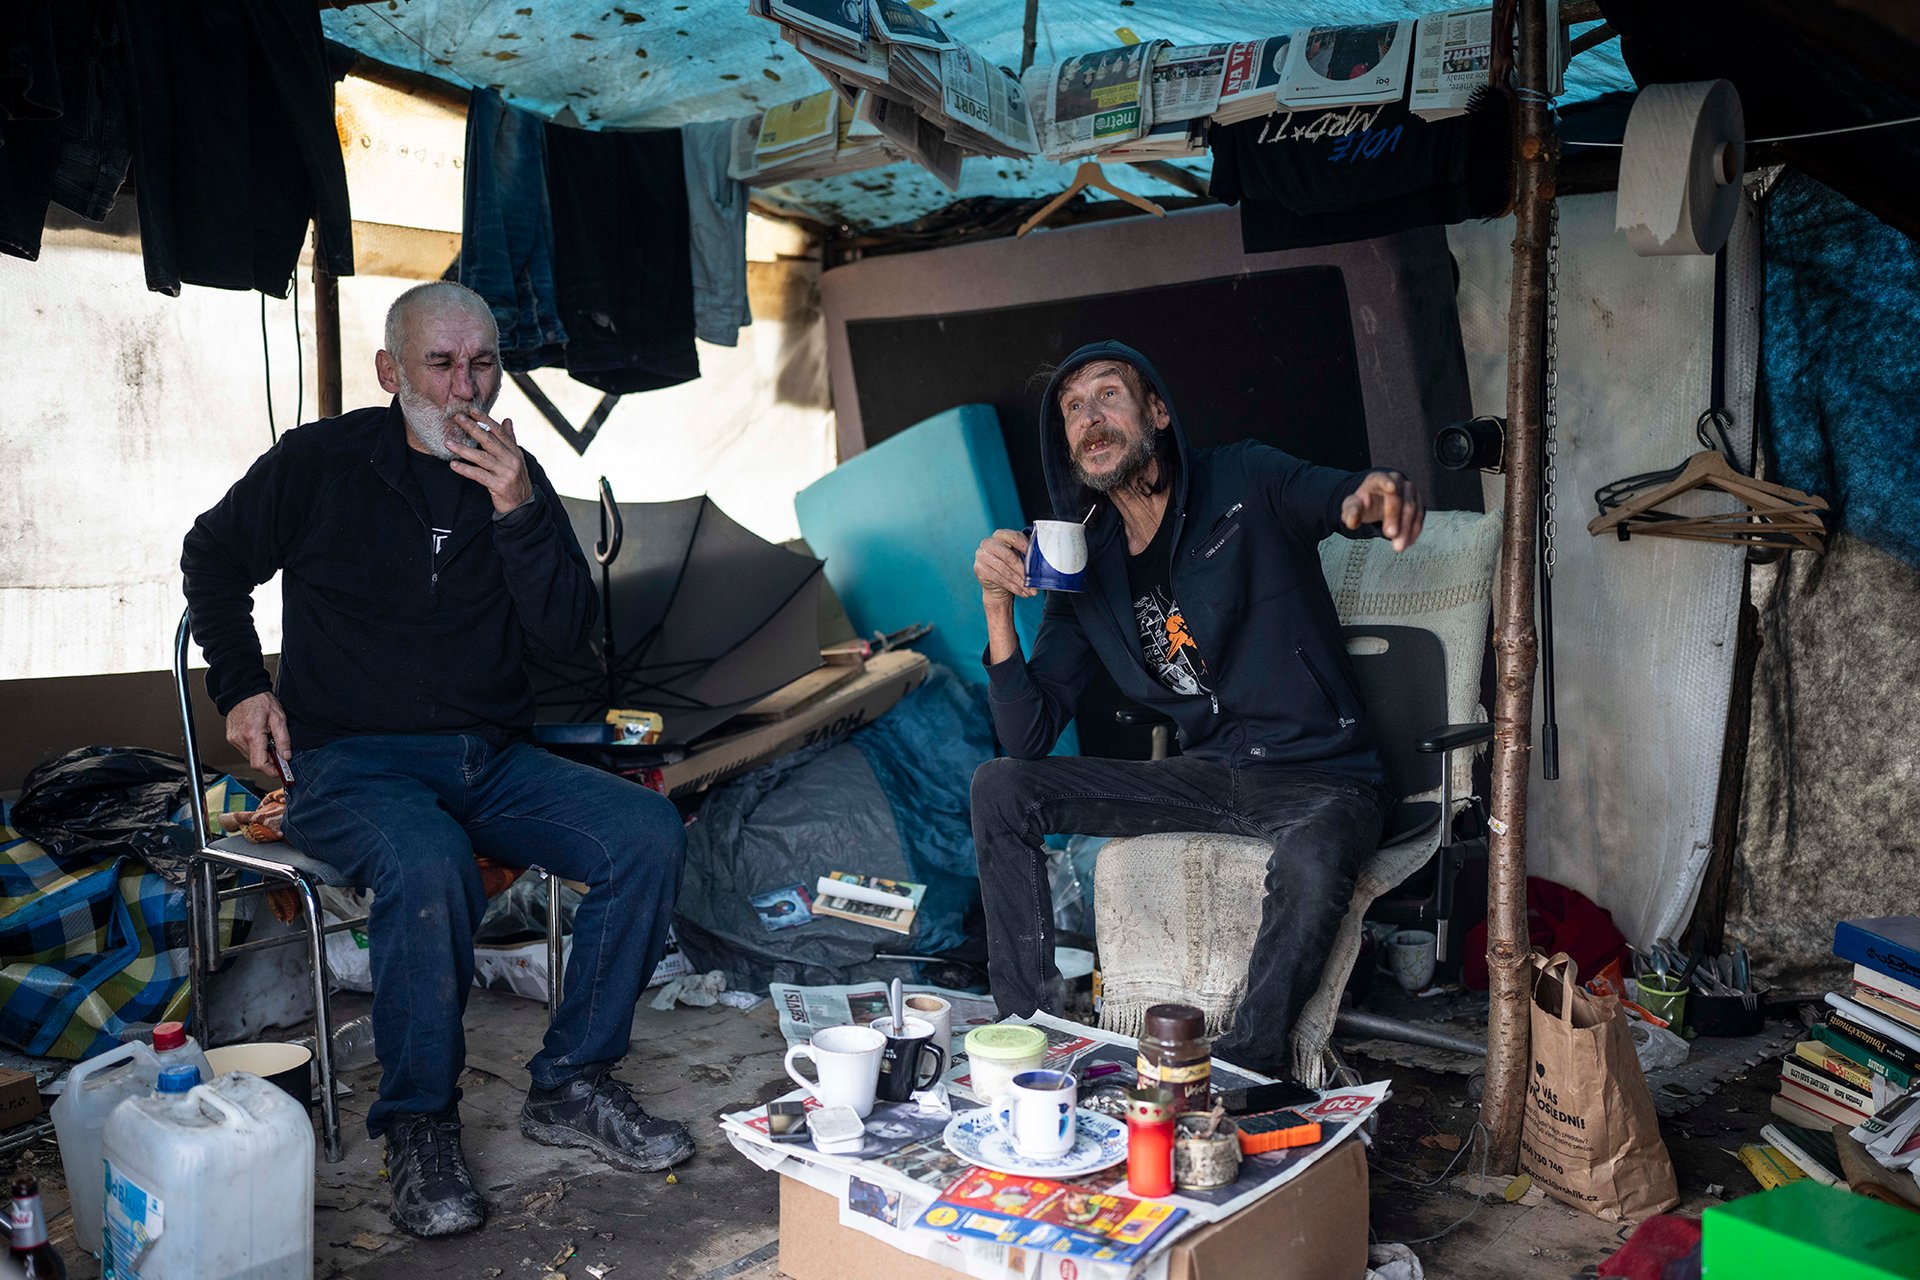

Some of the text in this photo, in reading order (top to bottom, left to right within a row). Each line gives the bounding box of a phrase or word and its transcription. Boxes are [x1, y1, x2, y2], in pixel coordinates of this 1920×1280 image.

[954, 95, 990, 123] SPORT
[1095, 110, 1137, 130] metro
[1535, 1100, 1586, 1130] OSLEDNÍ!
[1548, 1160, 1564, 1175] 740
[109, 1180, 144, 1214] dBlue
